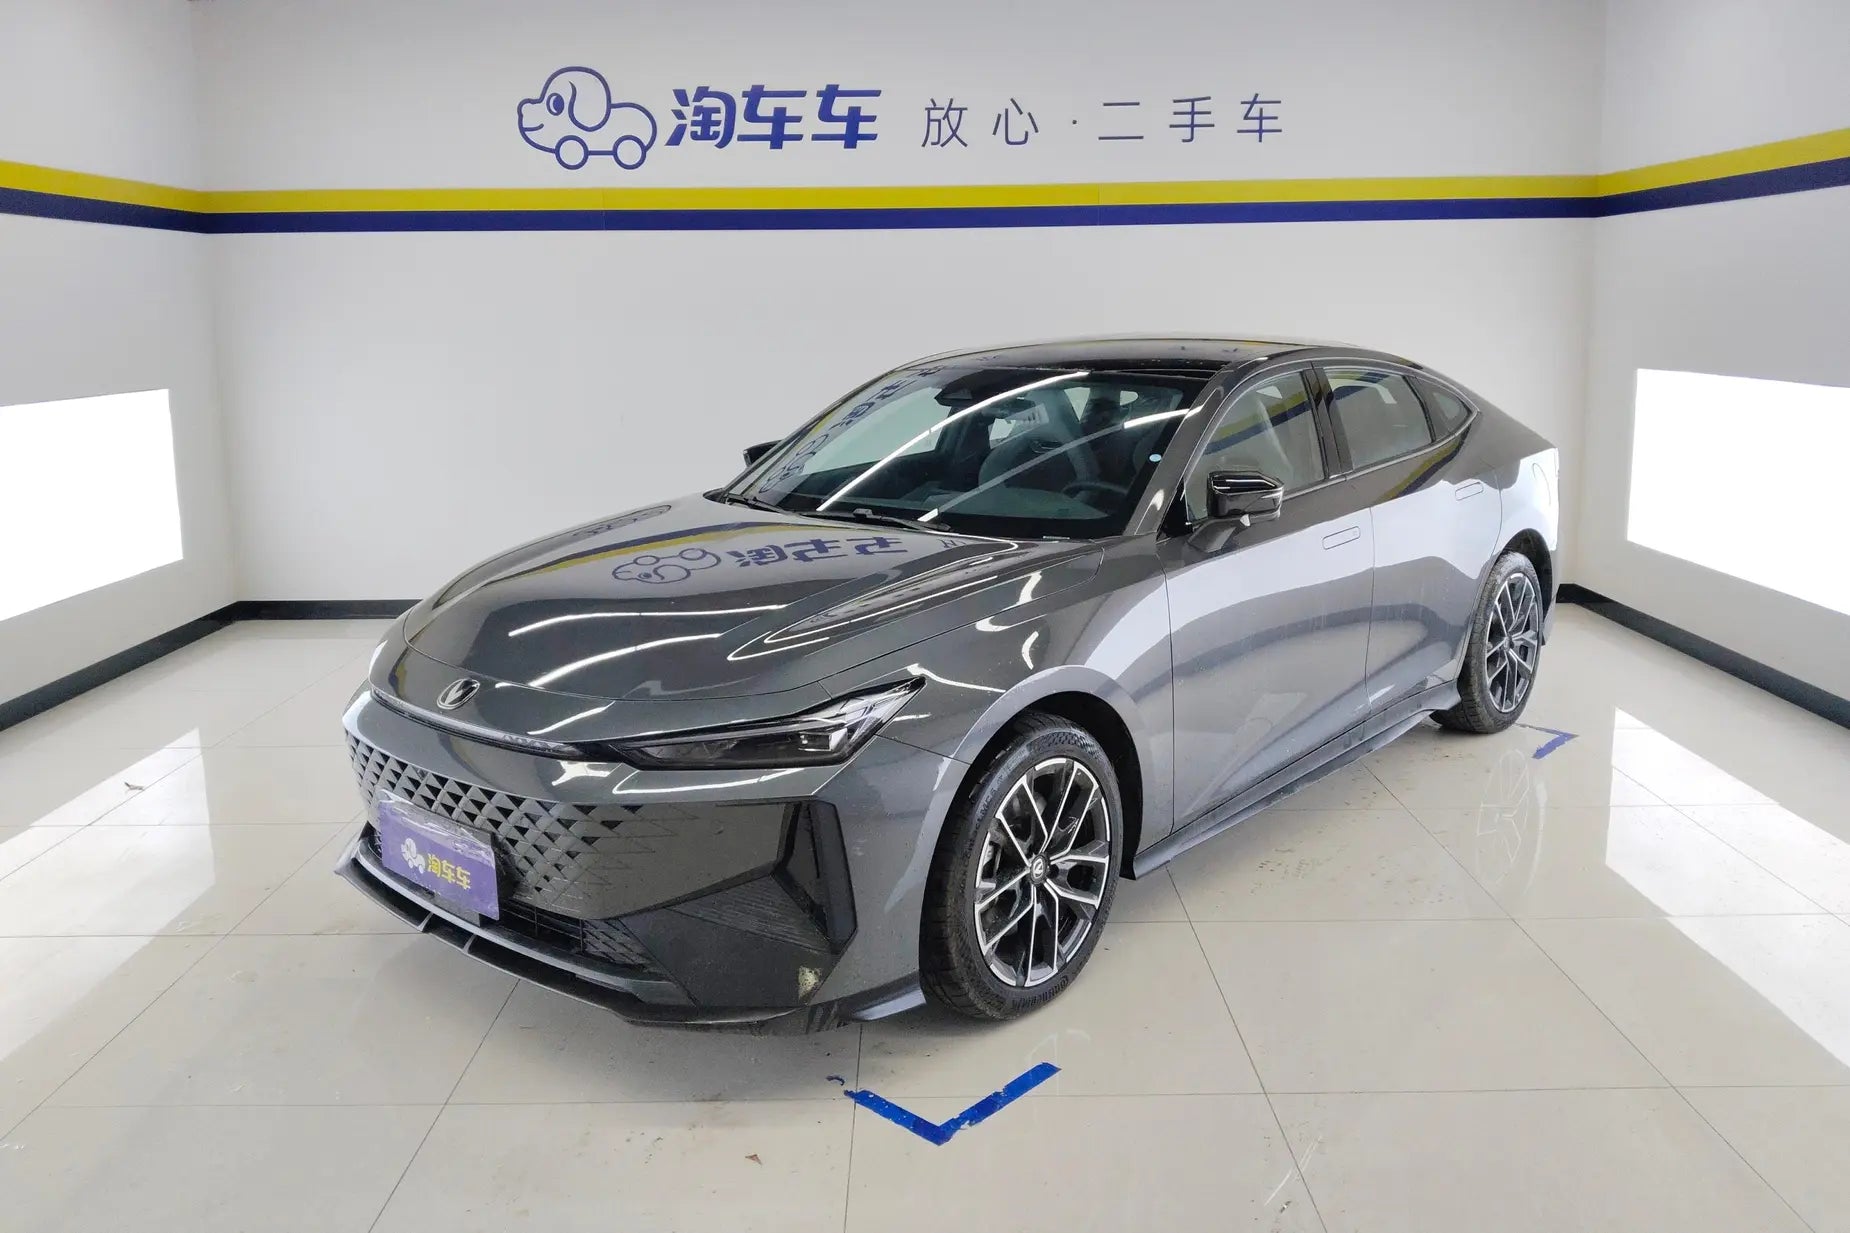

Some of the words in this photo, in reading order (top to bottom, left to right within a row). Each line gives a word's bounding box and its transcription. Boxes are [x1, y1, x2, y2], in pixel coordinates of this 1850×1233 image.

[666, 84, 882, 150] 淘车车
[426, 853, 471, 890] 淘车车
